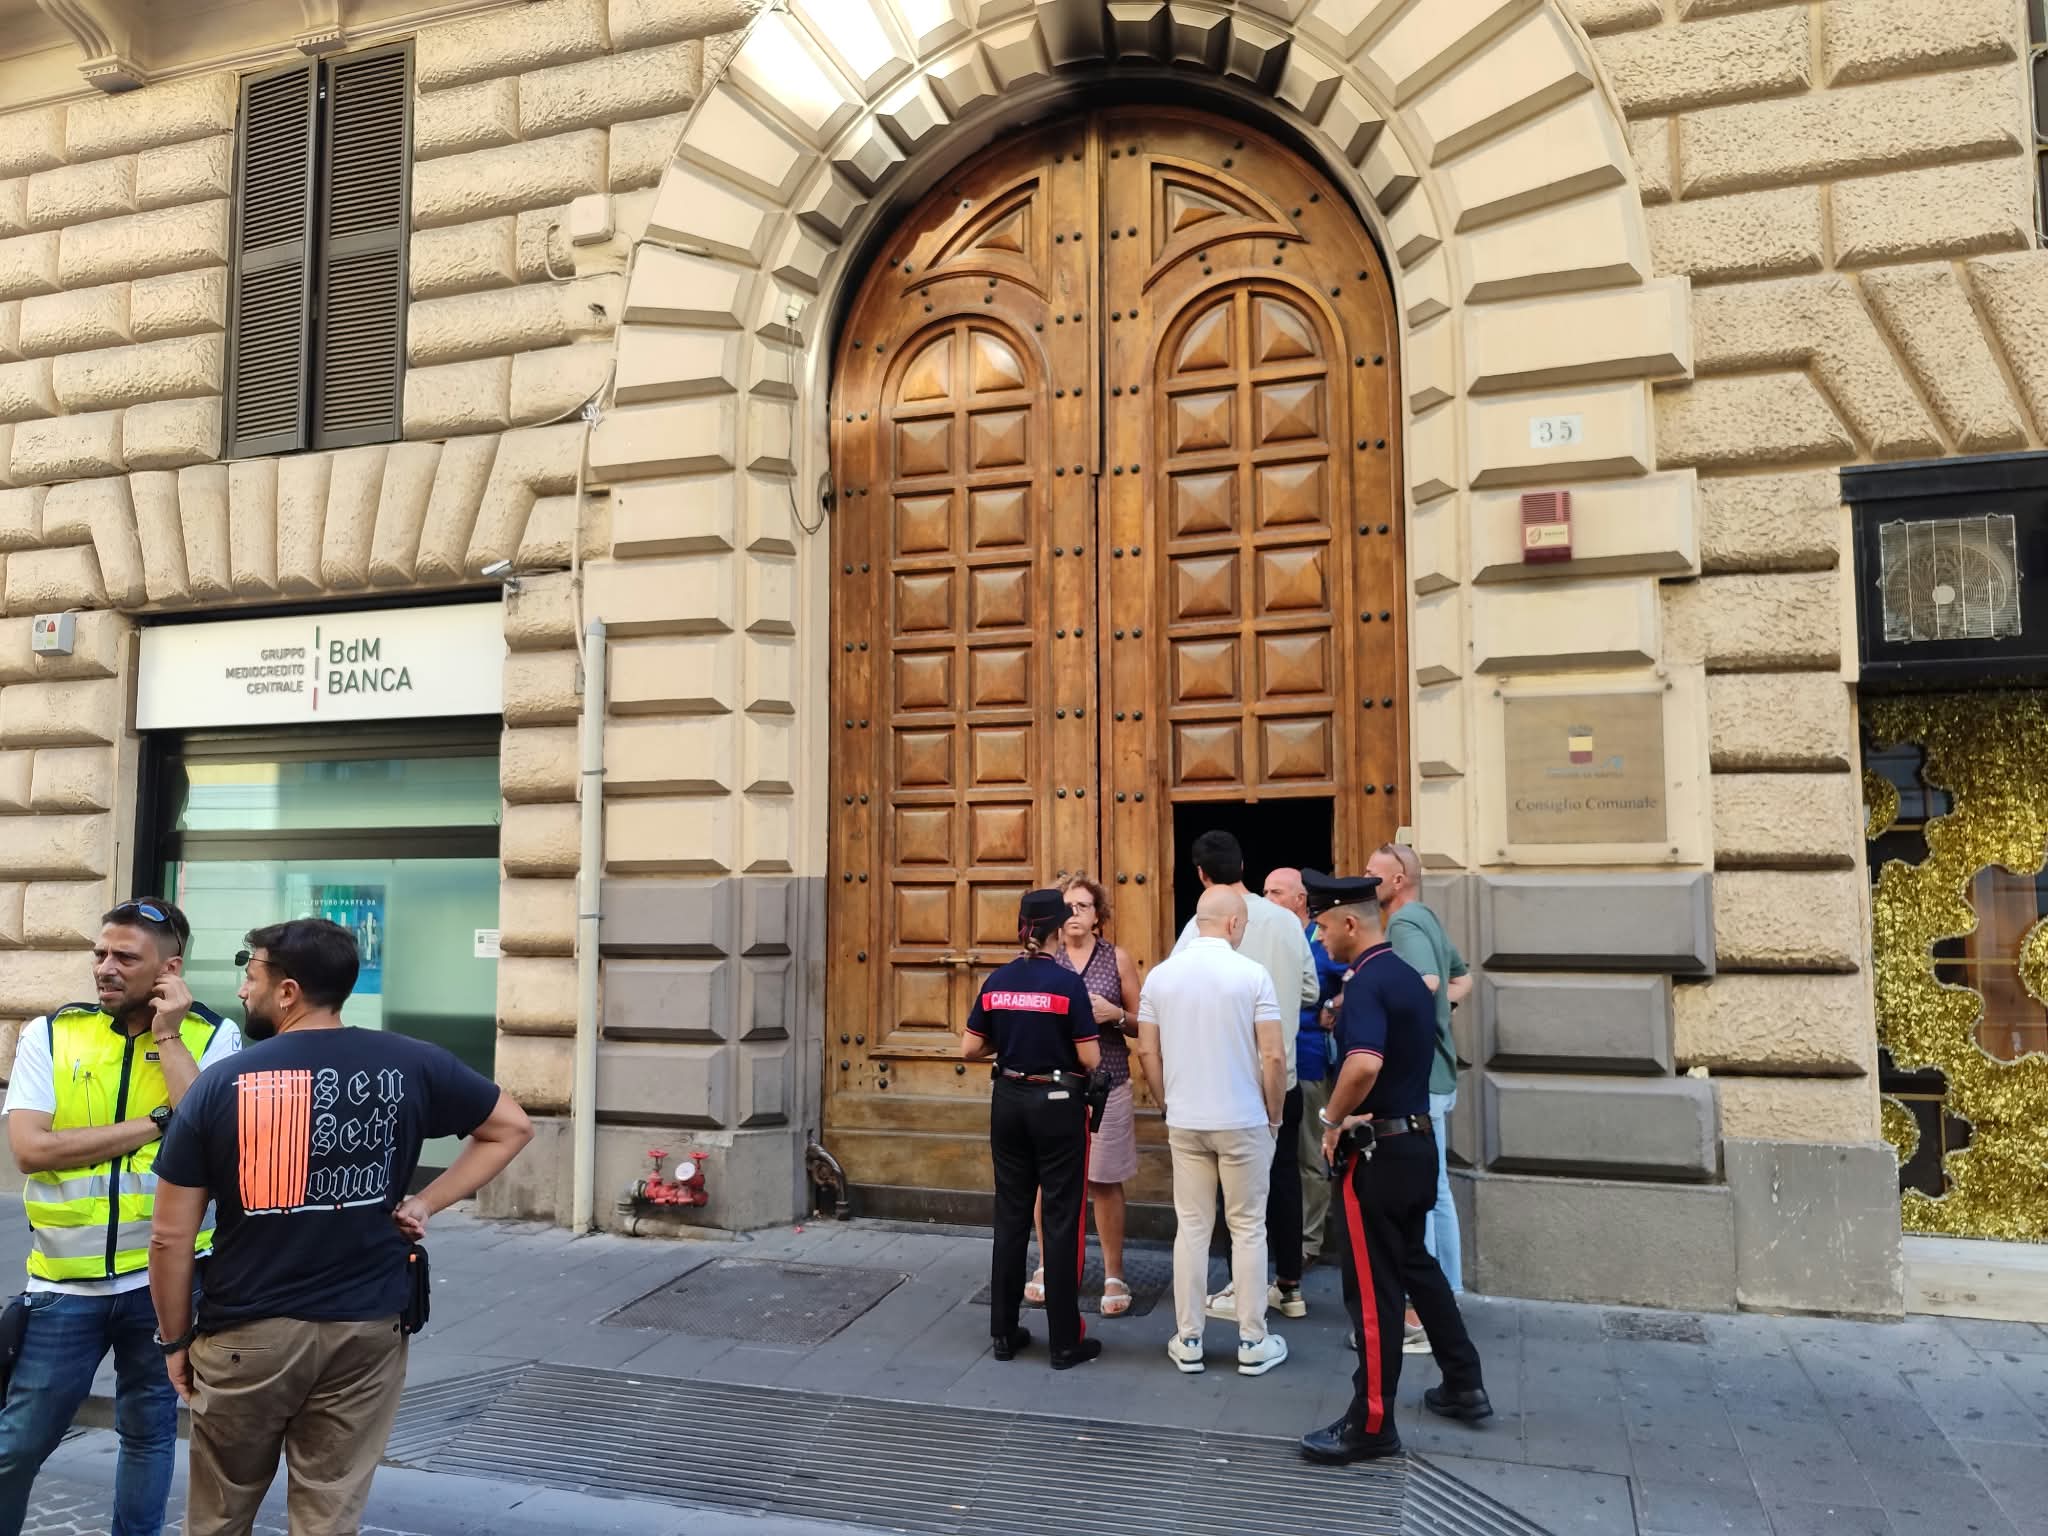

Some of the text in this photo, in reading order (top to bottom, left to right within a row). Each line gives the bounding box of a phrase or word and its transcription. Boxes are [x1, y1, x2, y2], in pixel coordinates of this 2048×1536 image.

[1539, 421, 1573, 443] 35
[261, 648, 305, 661] GRUPPO
[329, 638, 380, 665] BdM
[226, 664, 305, 679] MEDIOCREDITO
[247, 681, 304, 694] CENTRALE
[328, 667, 412, 695] BANCA
[1585, 796, 1657, 810] Comunale
